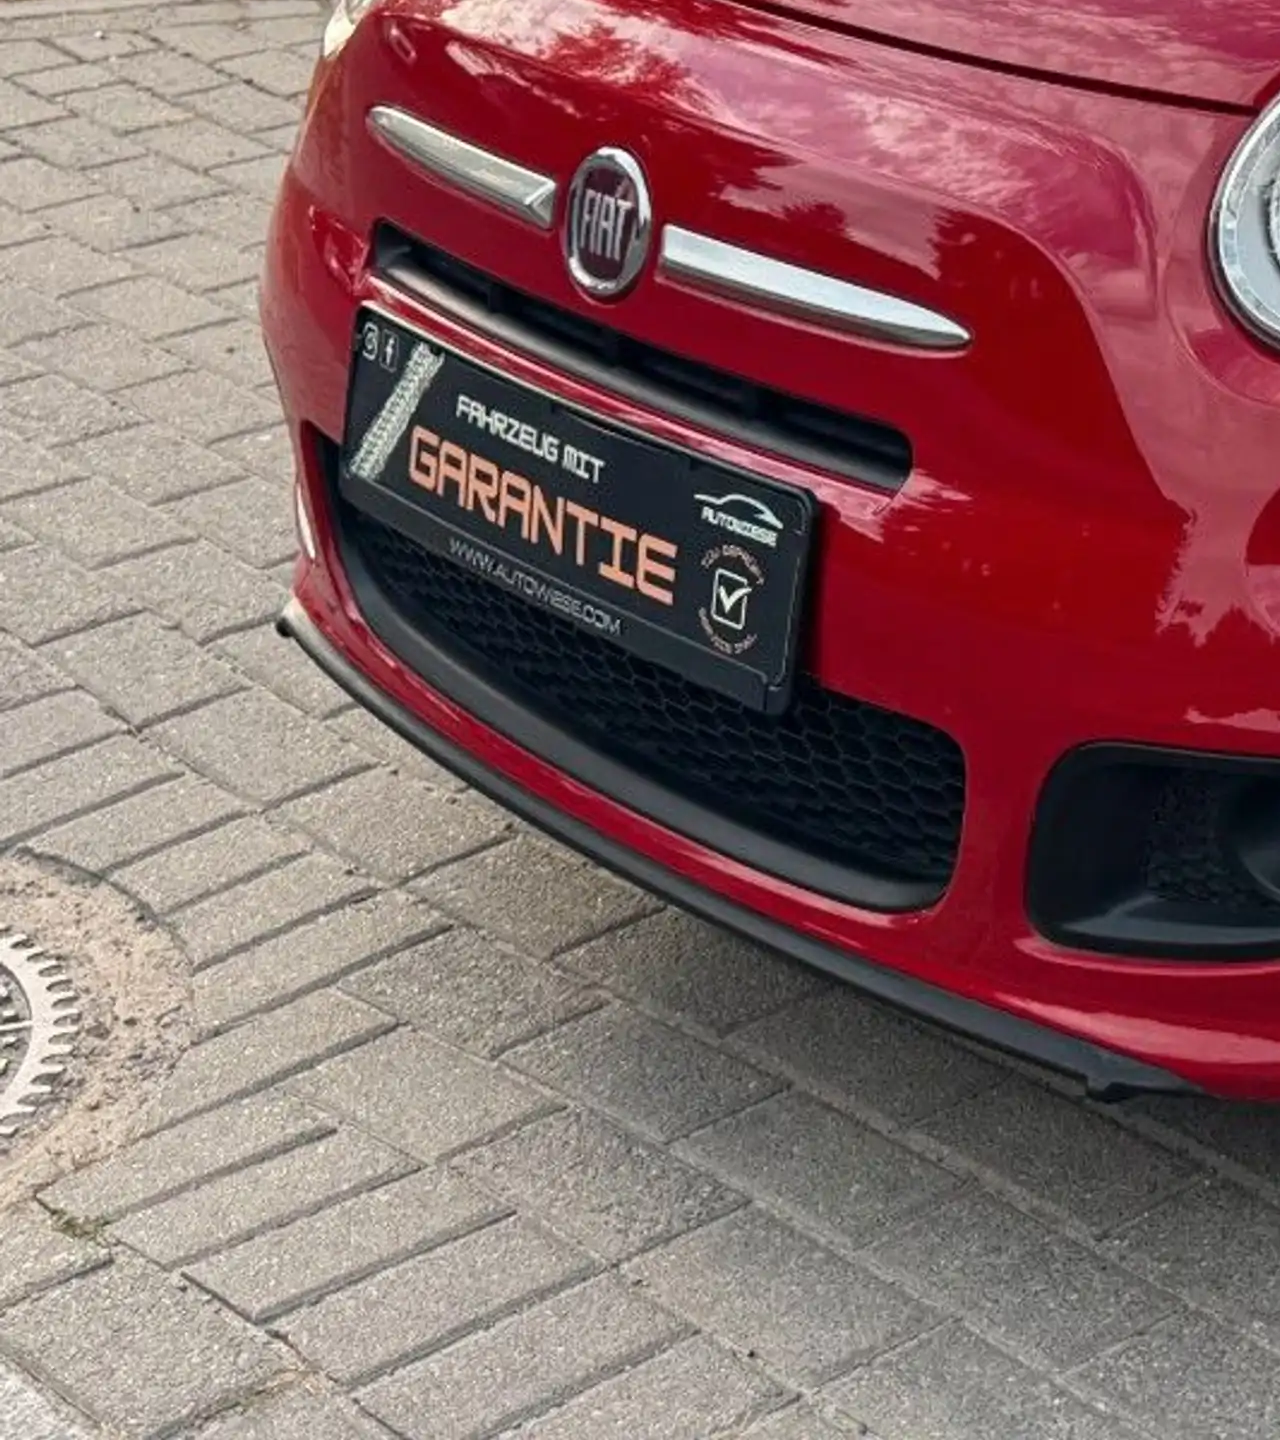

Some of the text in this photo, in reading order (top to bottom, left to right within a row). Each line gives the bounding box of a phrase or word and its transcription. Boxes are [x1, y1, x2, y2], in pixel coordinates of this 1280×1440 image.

[580, 188, 635, 261] FIAT
[455, 394, 606, 485] FAHRZEUG MIT
[408, 426, 679, 607] GARANTIE
